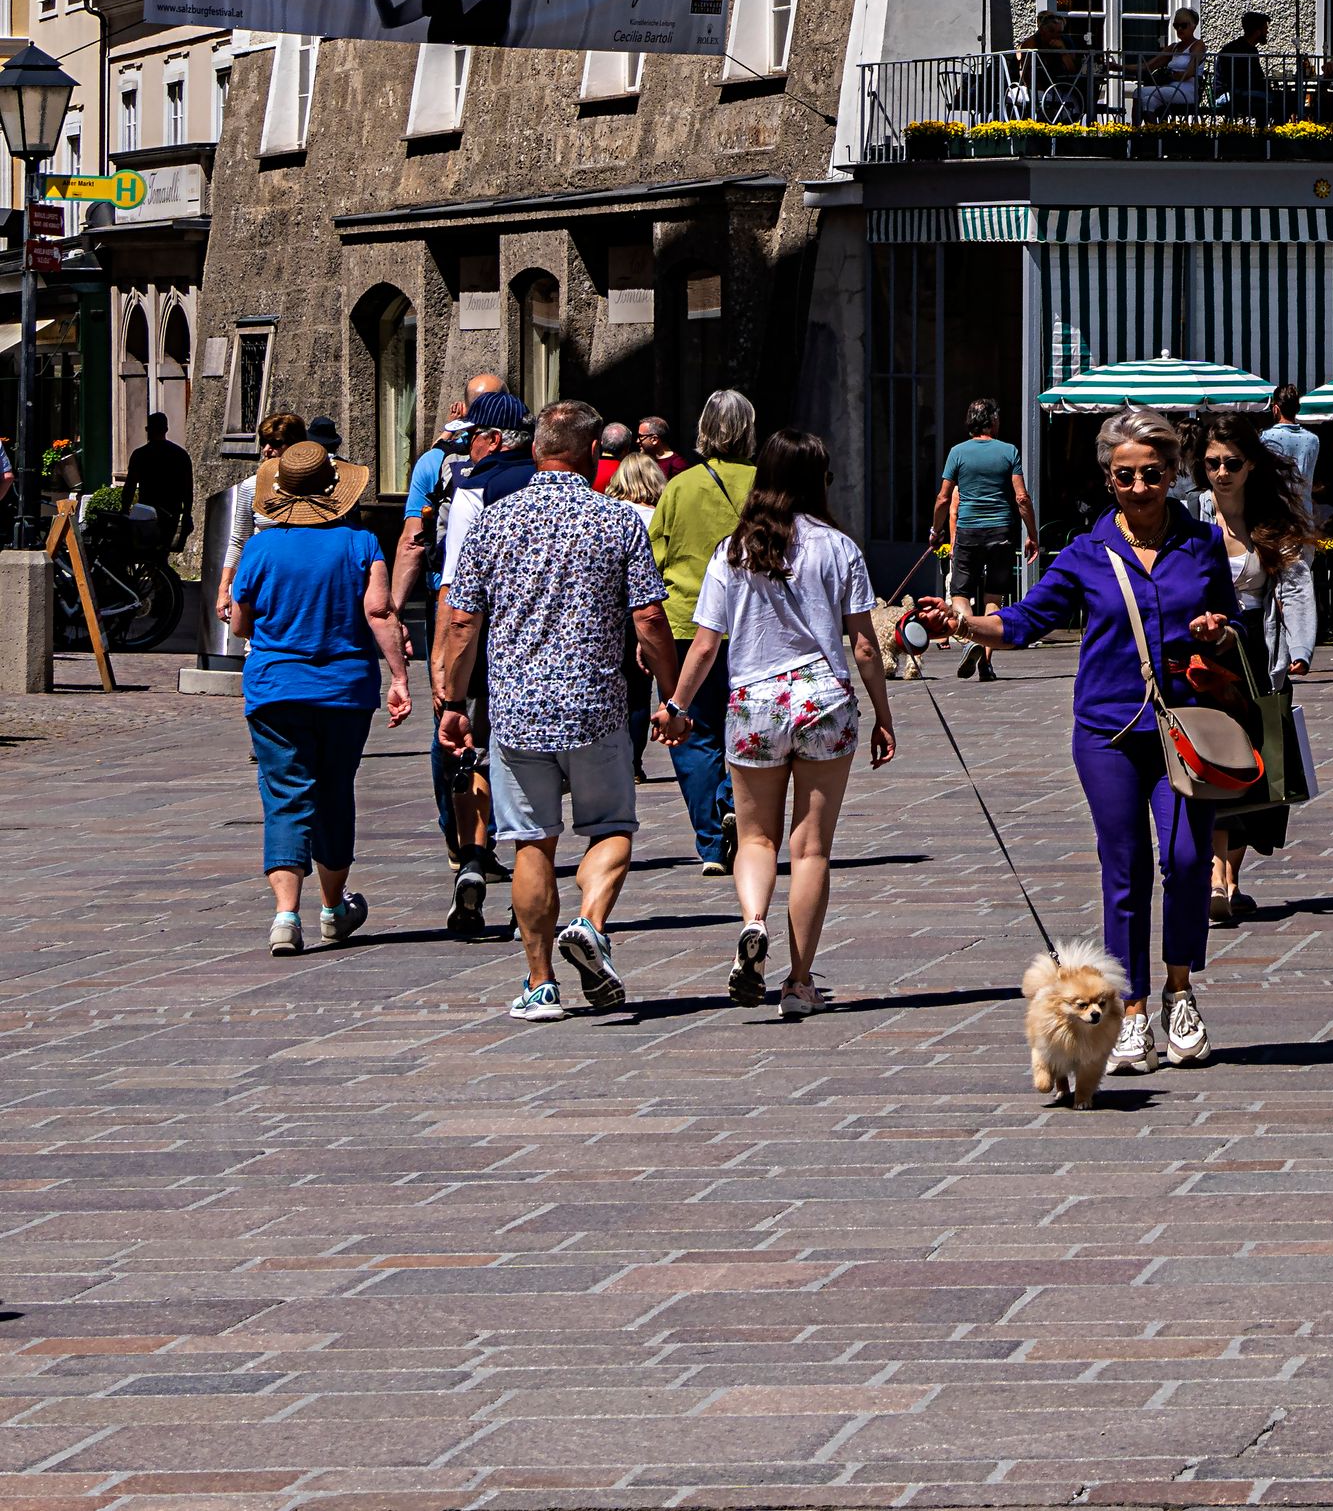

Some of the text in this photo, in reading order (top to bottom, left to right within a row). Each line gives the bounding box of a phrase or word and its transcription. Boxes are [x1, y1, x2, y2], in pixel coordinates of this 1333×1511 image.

[156, 2, 244, 18] www.salzburgfestival.at
[613, 29, 674, 44] Cecilia Bartoli
[78, 179, 95, 187] Markt
[116, 178, 136, 202] H
